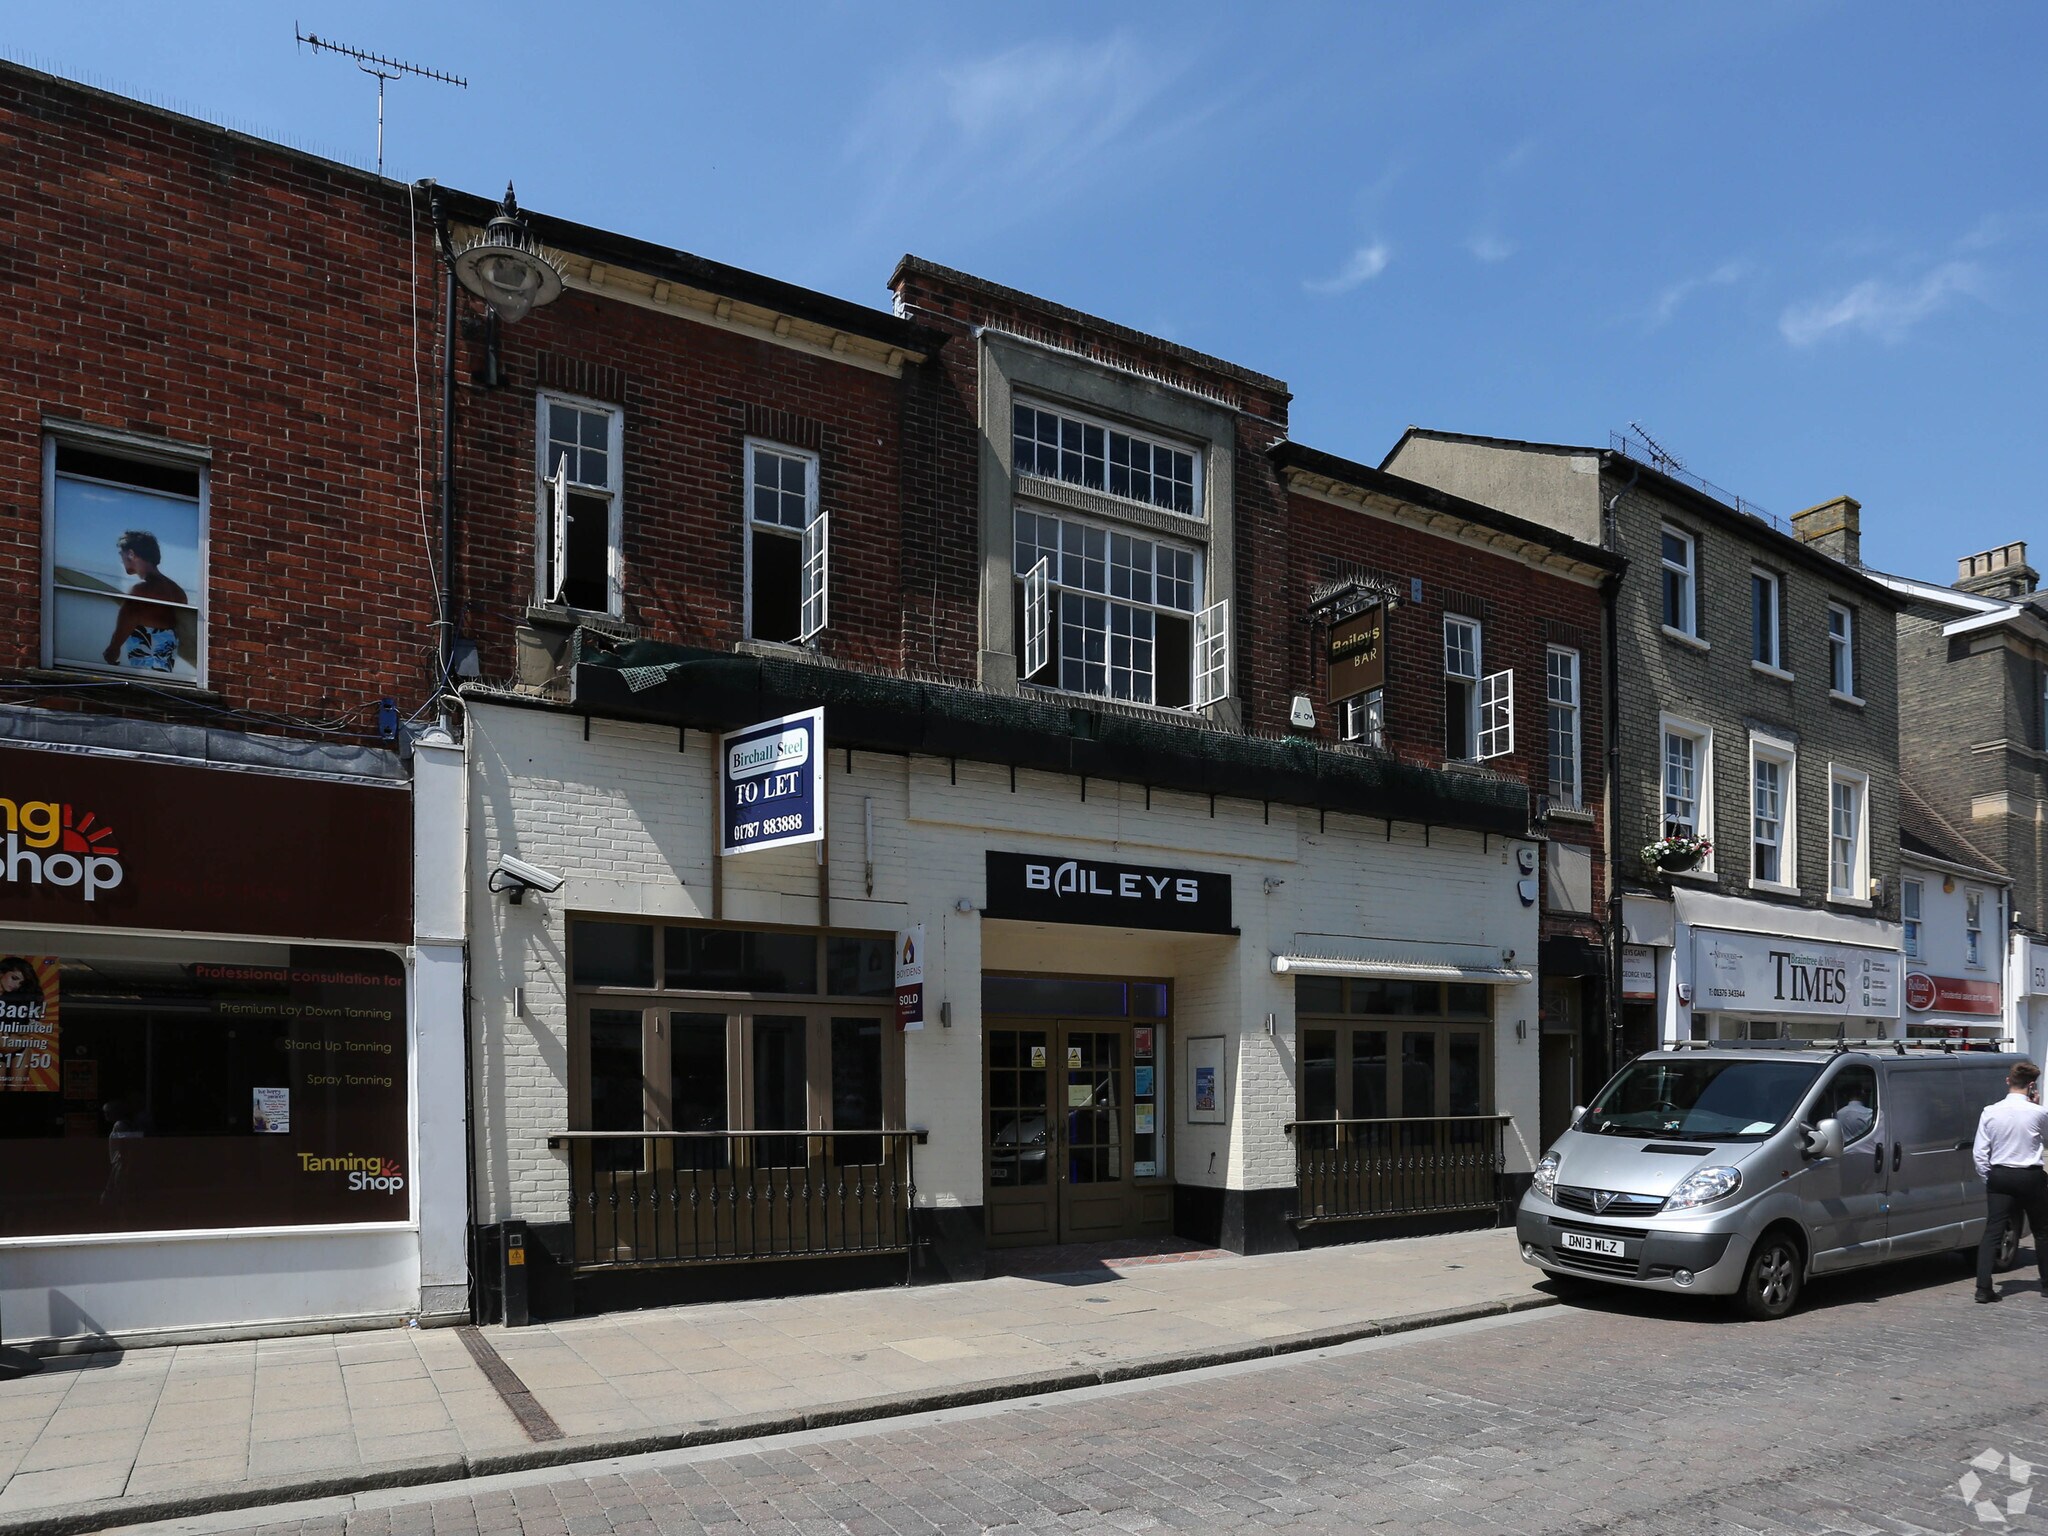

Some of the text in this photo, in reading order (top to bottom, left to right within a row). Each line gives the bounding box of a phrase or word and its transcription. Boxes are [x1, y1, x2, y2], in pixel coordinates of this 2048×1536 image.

[1332, 626, 1380, 657] Baileys
[1354, 648, 1377, 667] BAR
[733, 737, 803, 768] Birchall Steel
[735, 771, 799, 805] TO LET
[734, 813, 802, 841] 01787 883888
[0, 833, 123, 901] hop
[1025, 861, 1199, 903] BAILEYS
[1790, 952, 1846, 968] Braintree & Witham
[196, 965, 404, 987] Professional consultation for
[897, 966, 922, 979] BOYDENS
[1769, 951, 1846, 1005] TIMES
[2035, 967, 2046, 987] 53
[1908, 978, 1929, 991] Roland
[899, 993, 918, 1006] SOLD
[220, 1003, 392, 1021] Premium Lay Down Tanning
[2, 1036, 48, 1050] Tanning
[284, 1039, 392, 1054] Stand Up Tanning
[307, 1073, 392, 1087] Spray Tanning
[297, 1152, 381, 1176] Tanning
[348, 1171, 404, 1195] Shop
[1568, 1235, 1617, 1254] DN13 WLZ
